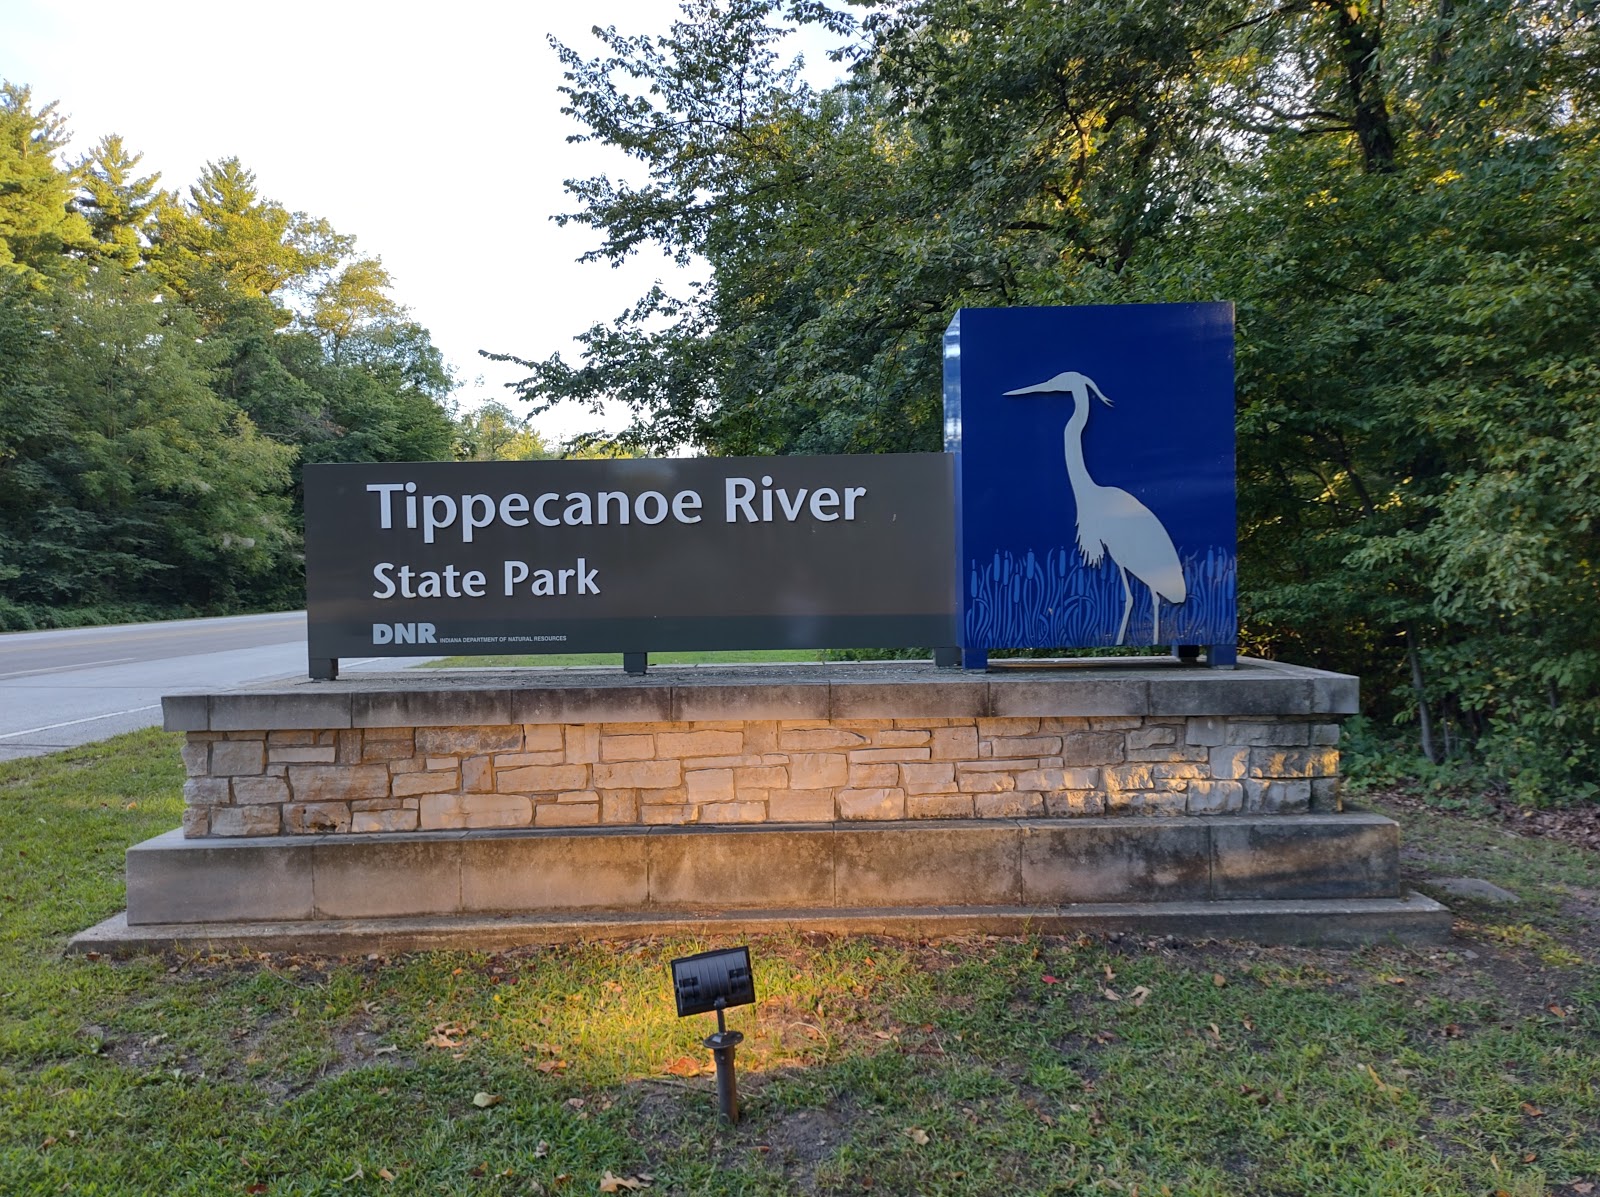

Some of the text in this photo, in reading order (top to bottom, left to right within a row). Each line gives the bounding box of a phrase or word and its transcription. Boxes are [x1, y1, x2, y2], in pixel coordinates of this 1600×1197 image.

[367, 476, 867, 543] Tippecanoe River
[373, 558, 600, 598] State Park
[373, 622, 437, 645] DNR
